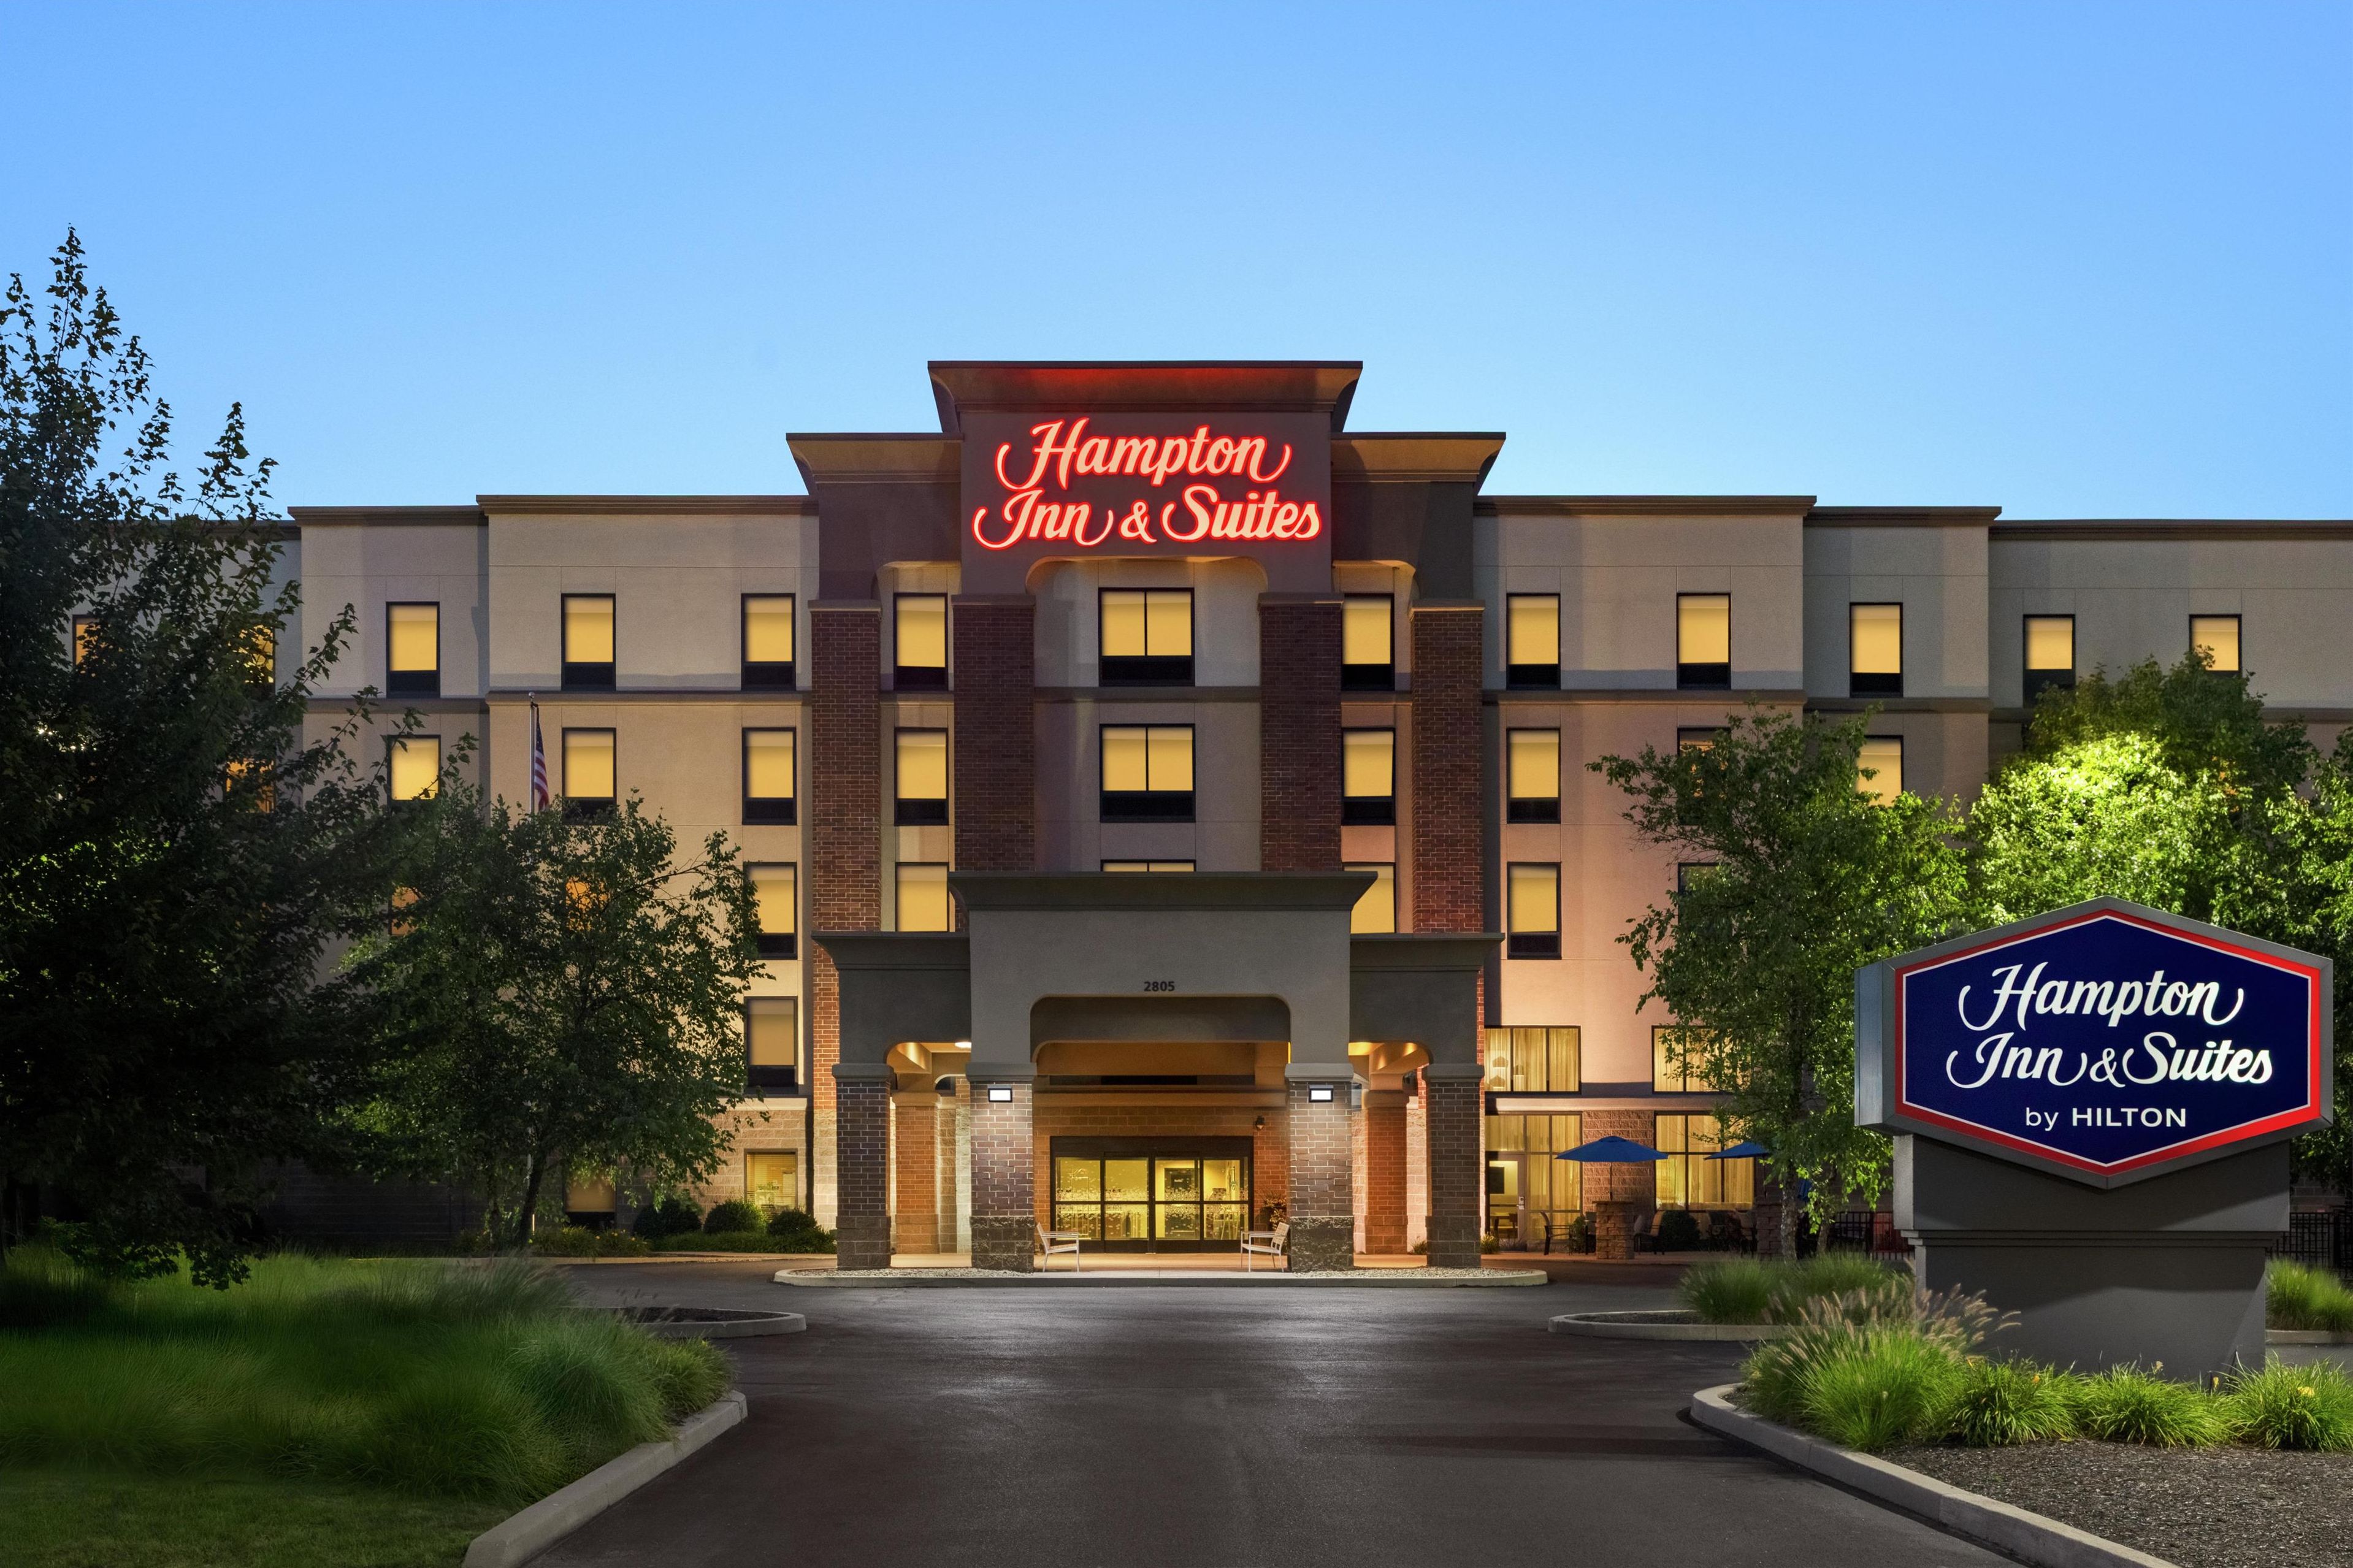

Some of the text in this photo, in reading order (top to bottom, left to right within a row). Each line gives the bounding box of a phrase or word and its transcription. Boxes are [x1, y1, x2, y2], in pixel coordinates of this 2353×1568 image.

[995, 417, 1291, 491] Hampton
[973, 484, 1321, 549] Inn & Suites
[1144, 981, 1175, 992] 2805
[1958, 961, 2244, 1031] Hampton
[1946, 1031, 2273, 1088] Inn & Suites
[2026, 1107, 2186, 1131] by HILTON
